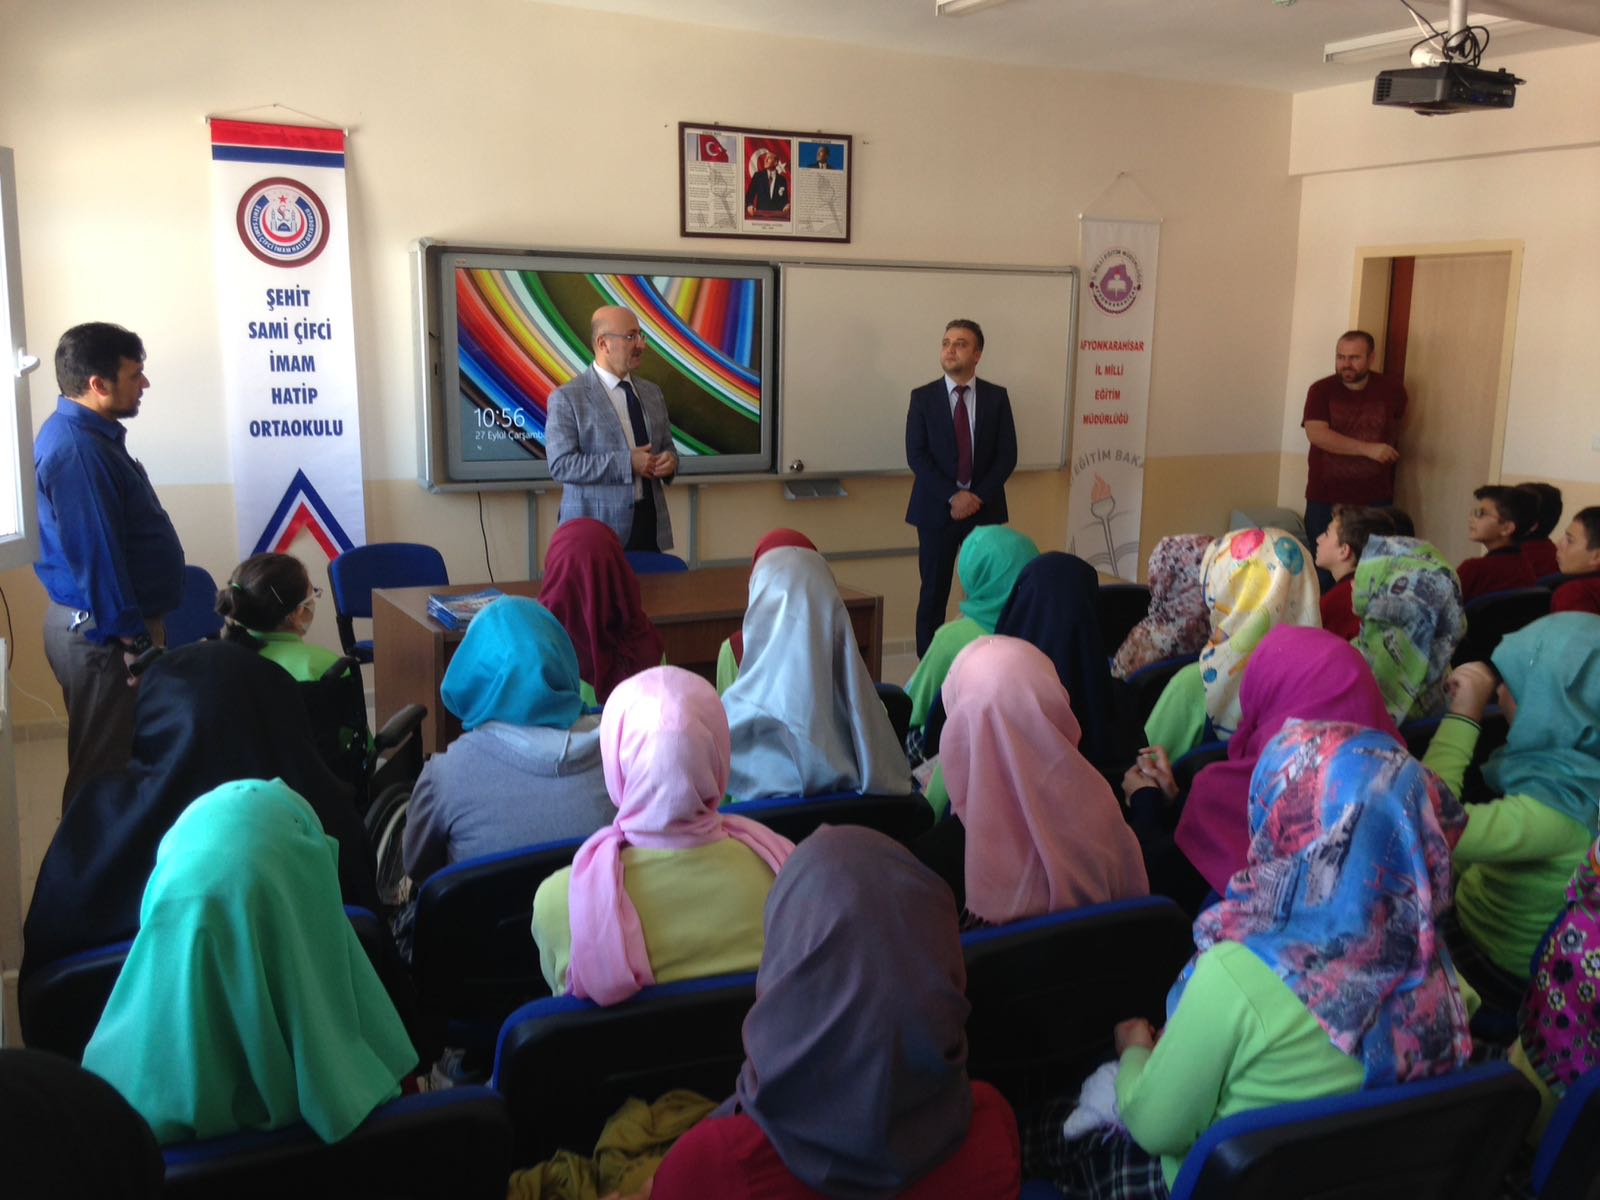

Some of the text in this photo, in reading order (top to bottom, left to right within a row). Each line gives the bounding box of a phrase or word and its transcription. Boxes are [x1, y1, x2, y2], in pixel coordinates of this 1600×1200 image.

[266, 284, 310, 311] ŞEHİT
[248, 317, 332, 344] SAMİ ÇİFCİ
[269, 350, 315, 372] İMAM
[1095, 363, 1124, 376] İL MİLLİ
[271, 382, 318, 404] HATİP
[1094, 388, 1120, 400] EĞİTİM
[474, 408, 525, 427] 10:56
[1082, 412, 1129, 424] MÜDÜRLÜĞÜ
[249, 420, 343, 437] ORTAOKULU
[475, 431, 486, 440] 27
[488, 430, 506, 441] Eylül
